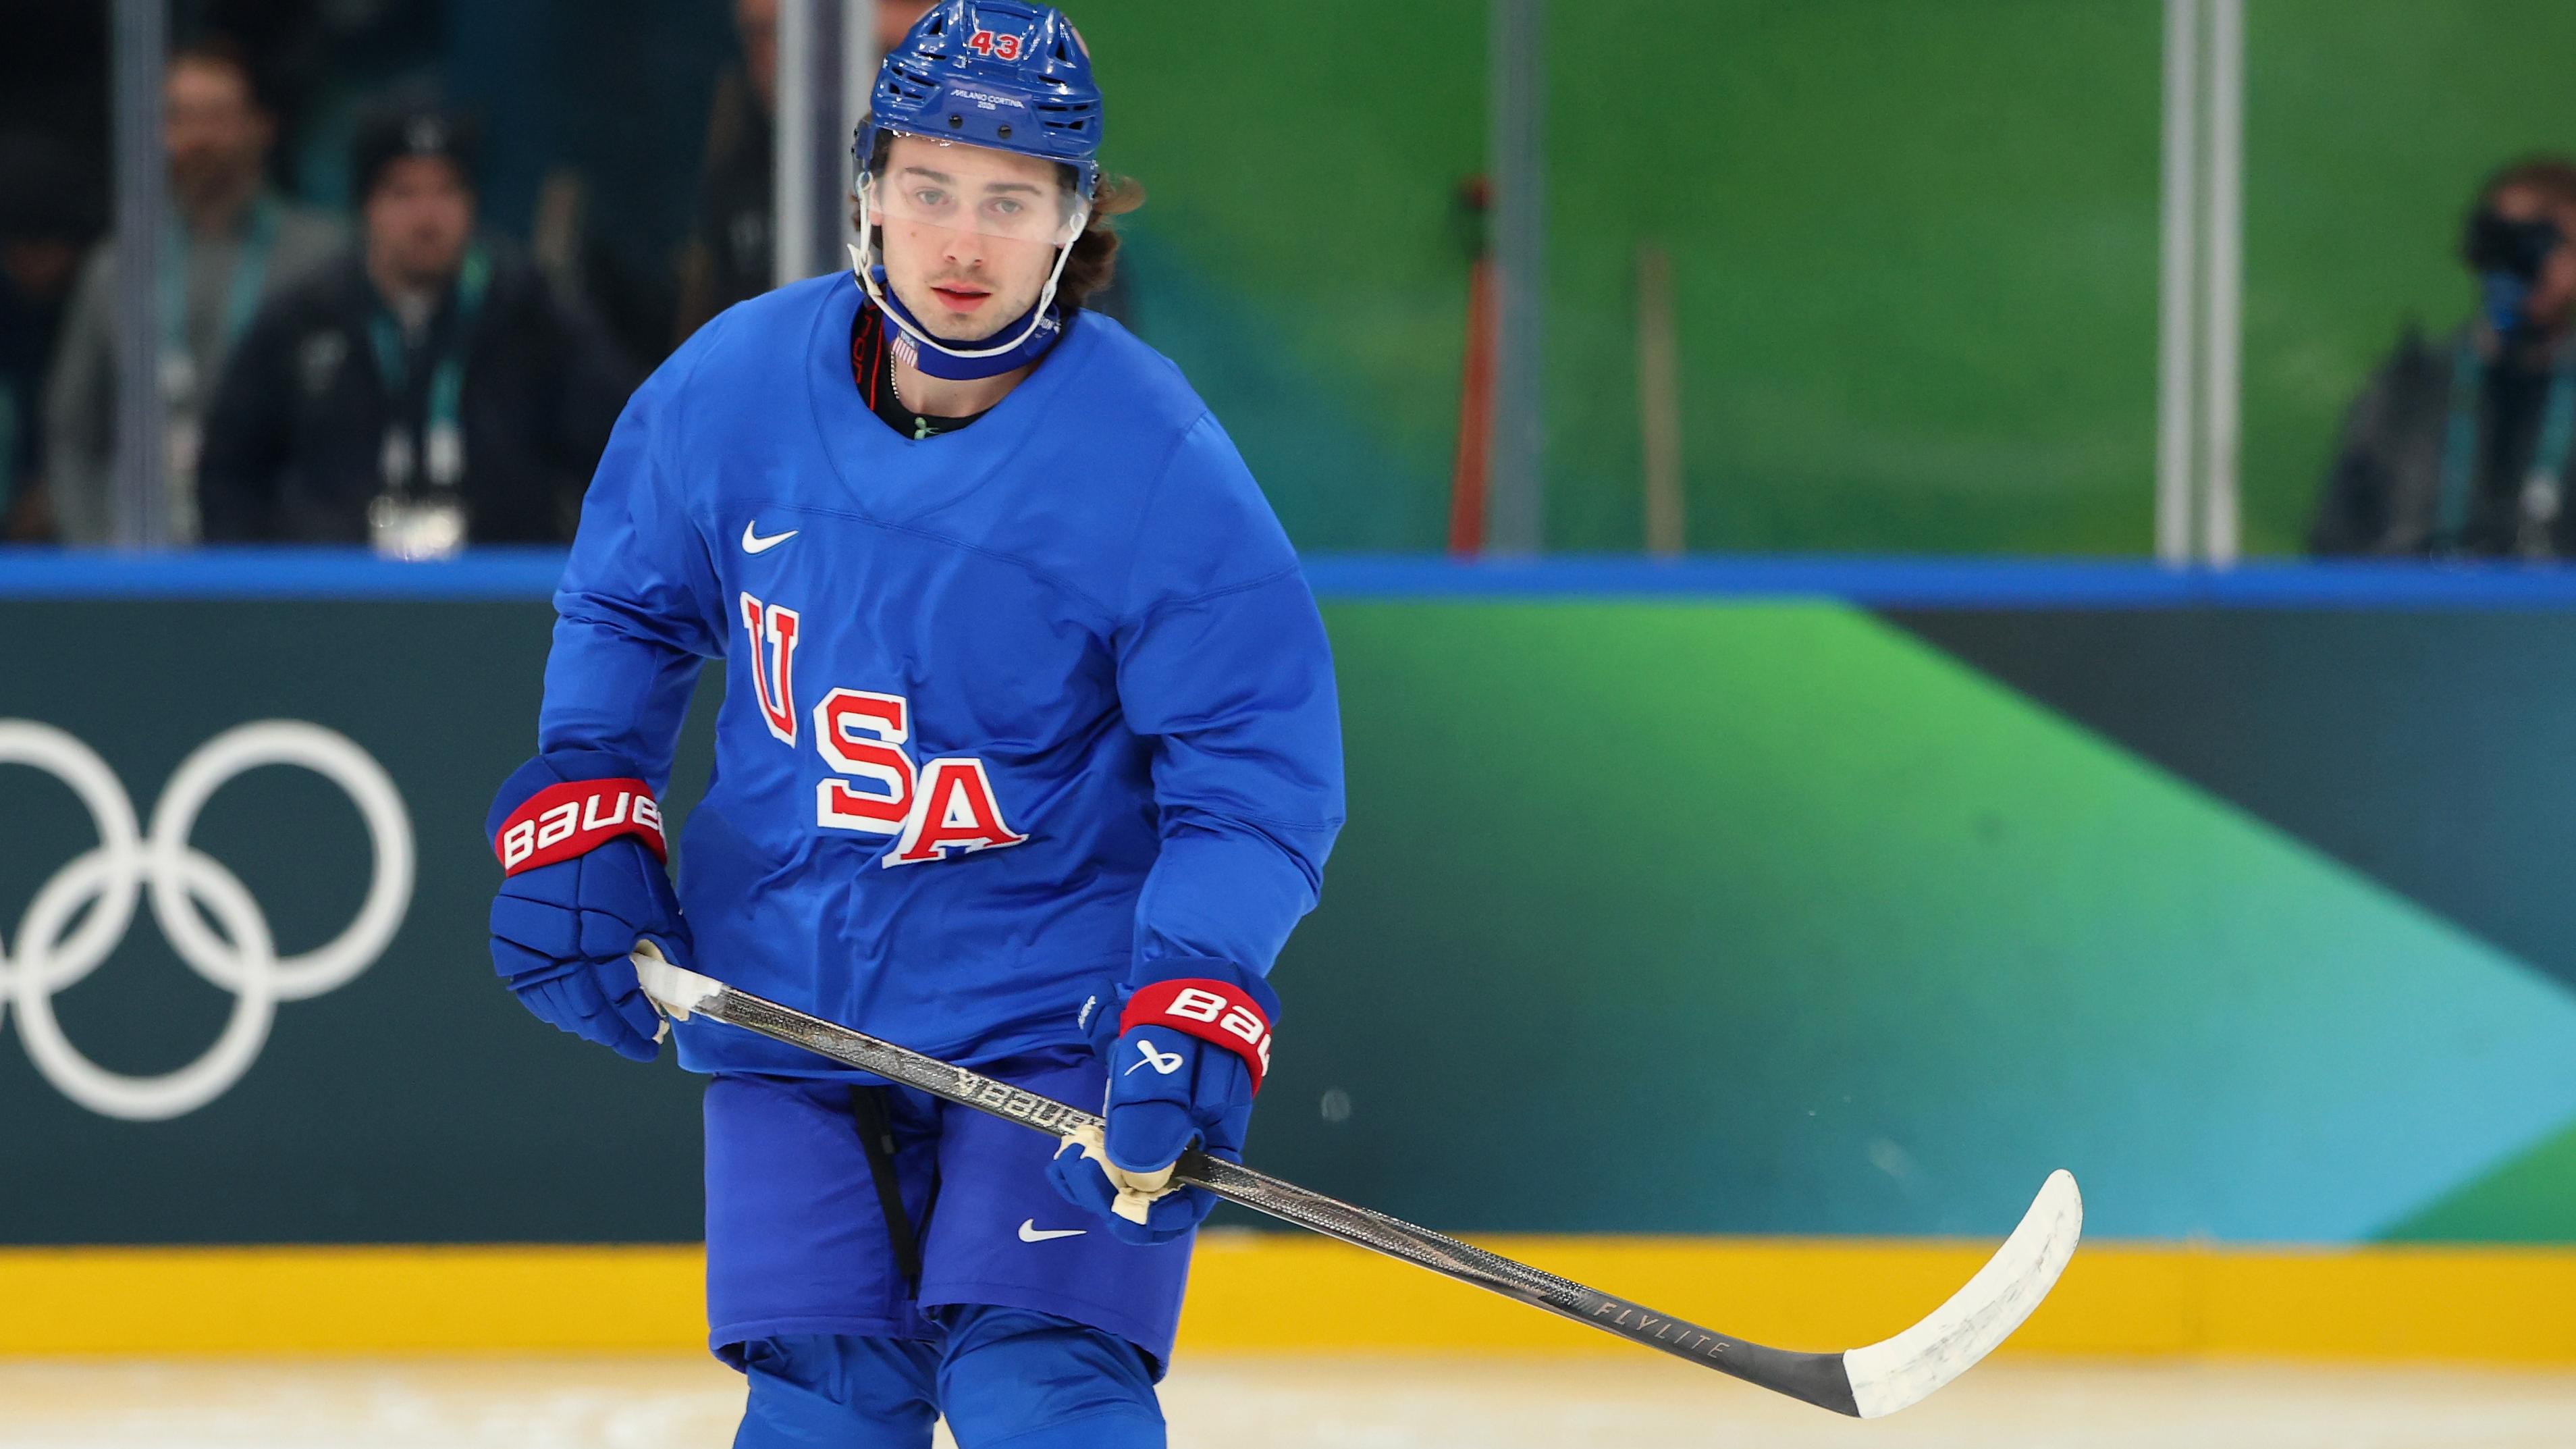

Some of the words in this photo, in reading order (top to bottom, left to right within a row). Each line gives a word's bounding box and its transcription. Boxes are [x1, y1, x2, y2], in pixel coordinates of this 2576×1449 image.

[969, 30, 1022, 61] 43
[950, 88, 987, 102] MILANO
[988, 95, 1025, 109] CORTINA
[977, 101, 997, 111] 2026
[740, 591, 1029, 870] USA
[1592, 1302, 1730, 1359] FLYLITE
